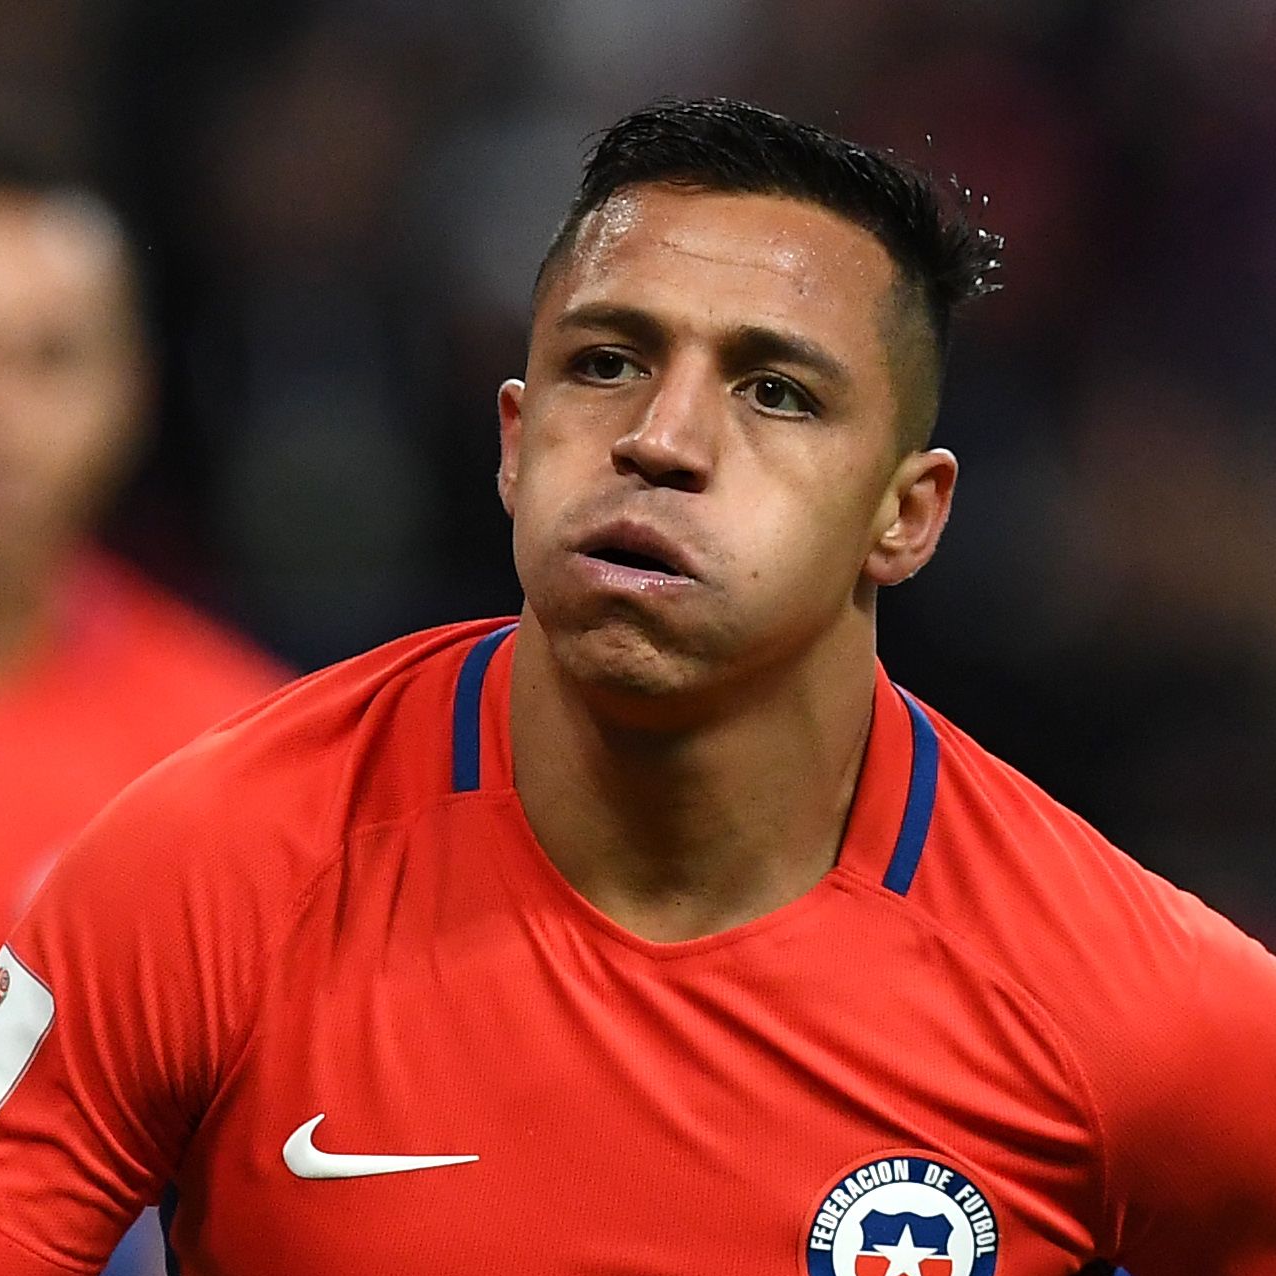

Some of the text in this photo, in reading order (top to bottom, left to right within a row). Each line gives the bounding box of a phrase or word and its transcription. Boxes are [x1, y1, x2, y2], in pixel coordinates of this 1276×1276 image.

[810, 1159, 997, 1258] FEDERACION DE FUTBOL
